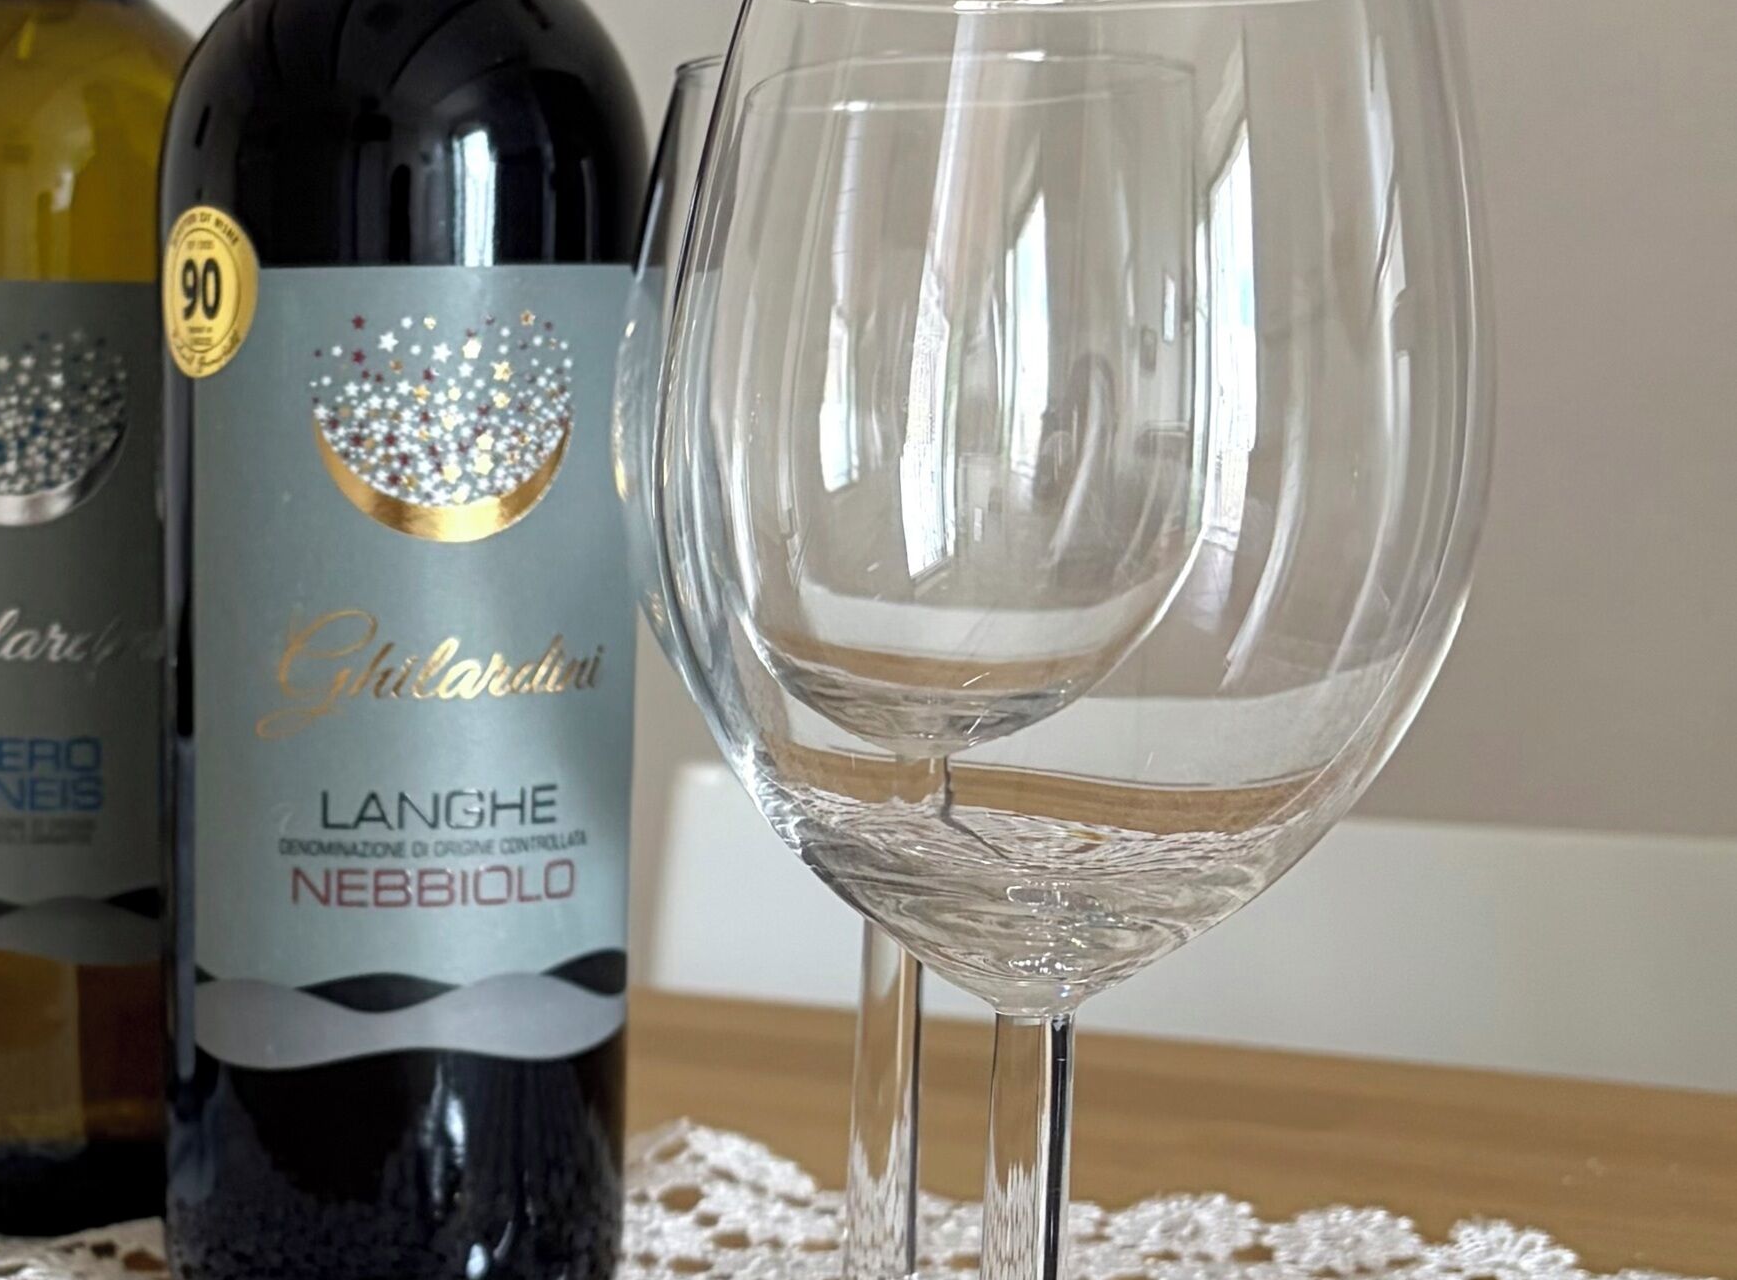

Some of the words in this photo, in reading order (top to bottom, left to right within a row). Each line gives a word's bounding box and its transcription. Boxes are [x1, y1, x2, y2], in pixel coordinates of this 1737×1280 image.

[181, 257, 222, 321] 90
[256, 606, 605, 740] Ghilardini
[320, 783, 559, 830] LANGHE
[279, 837, 406, 859] DENOMINAZIONE
[410, 839, 430, 858] DI
[433, 837, 495, 858] ORIGINE
[499, 829, 588, 853] CONTROLLATA
[291, 858, 576, 908] NEBBIOLO
